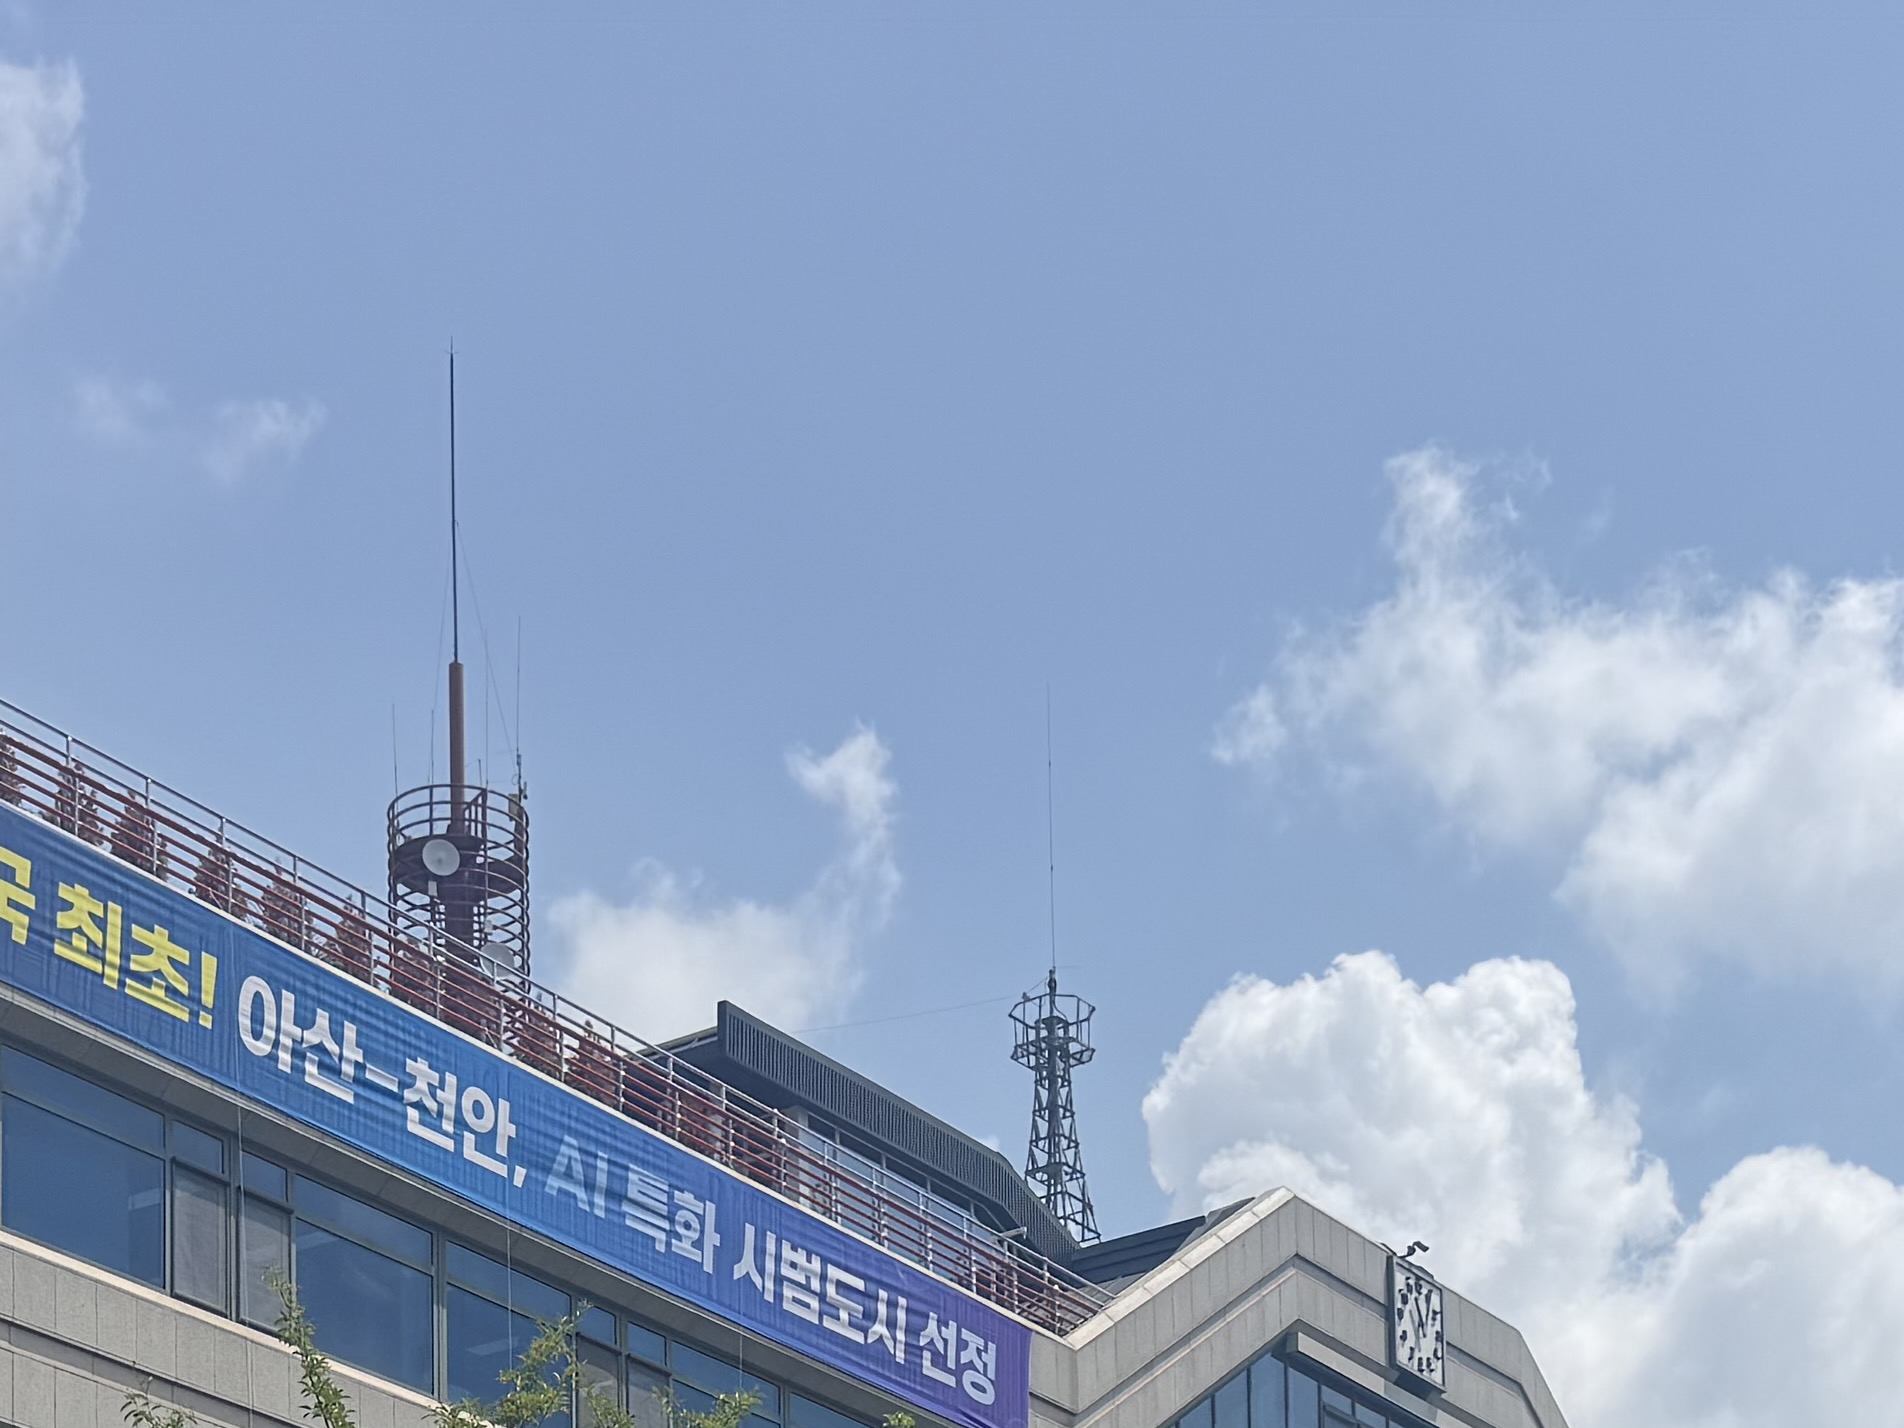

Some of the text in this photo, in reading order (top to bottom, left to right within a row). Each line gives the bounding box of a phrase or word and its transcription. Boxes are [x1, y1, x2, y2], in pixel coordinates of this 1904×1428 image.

[54, 882, 218, 1030] 최초!
[237, 975, 526, 1187] 아산-천안,
[545, 1135, 609, 1219] AI
[626, 1173, 719, 1273] 특화
[733, 1223, 908, 1364] 시범도시
[919, 1309, 998, 1405] 선정
